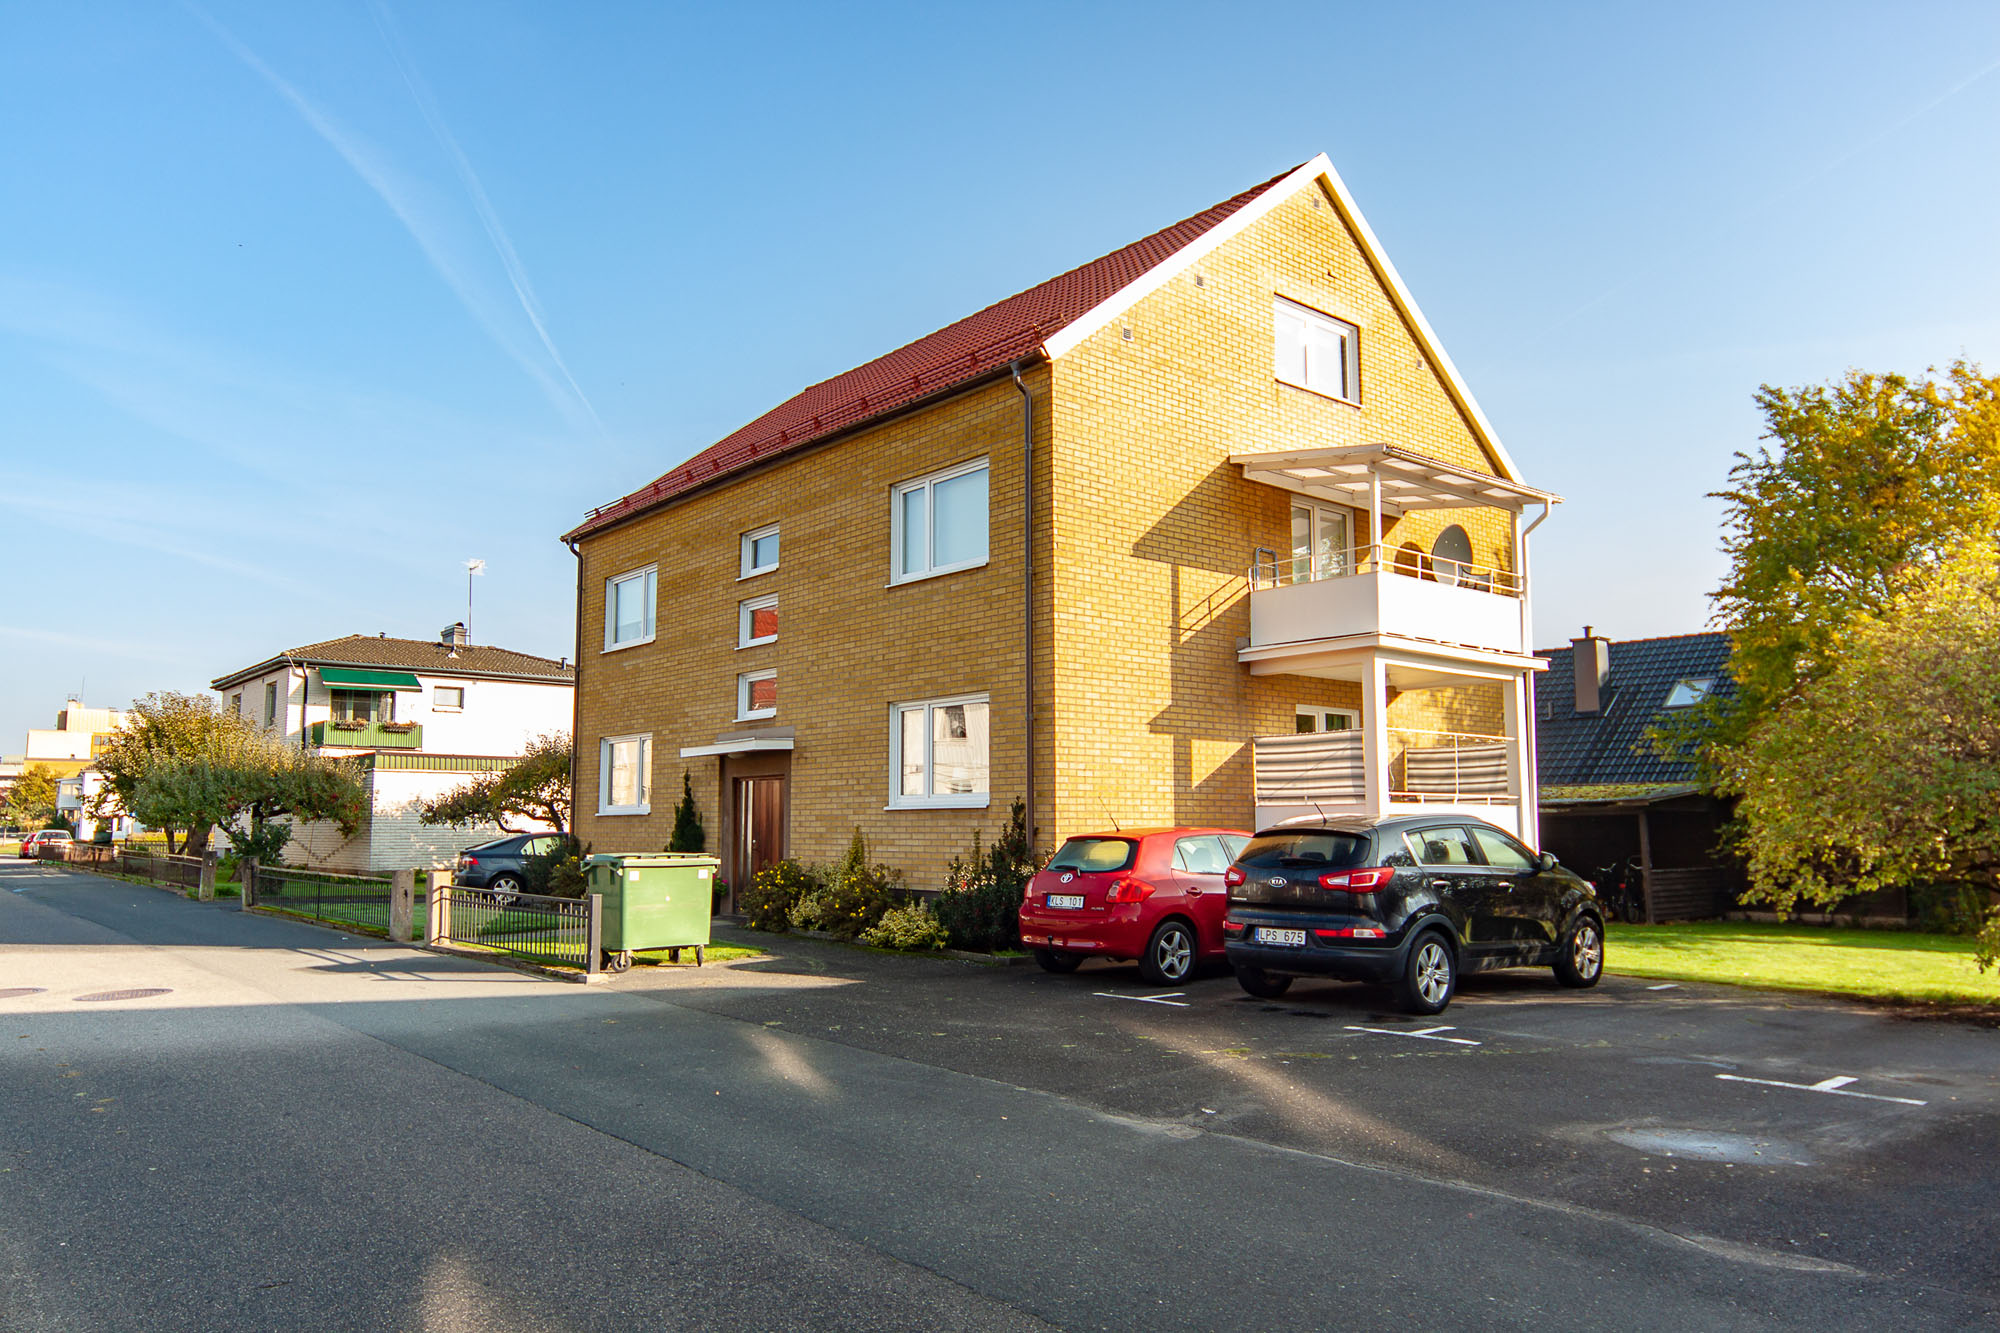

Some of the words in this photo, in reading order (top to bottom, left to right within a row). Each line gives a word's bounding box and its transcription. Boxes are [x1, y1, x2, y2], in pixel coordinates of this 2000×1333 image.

[1050, 896, 1064, 905] KLS
[1069, 897, 1082, 906] 101
[1260, 928, 1278, 941] LPS
[1284, 931, 1303, 943] 675
